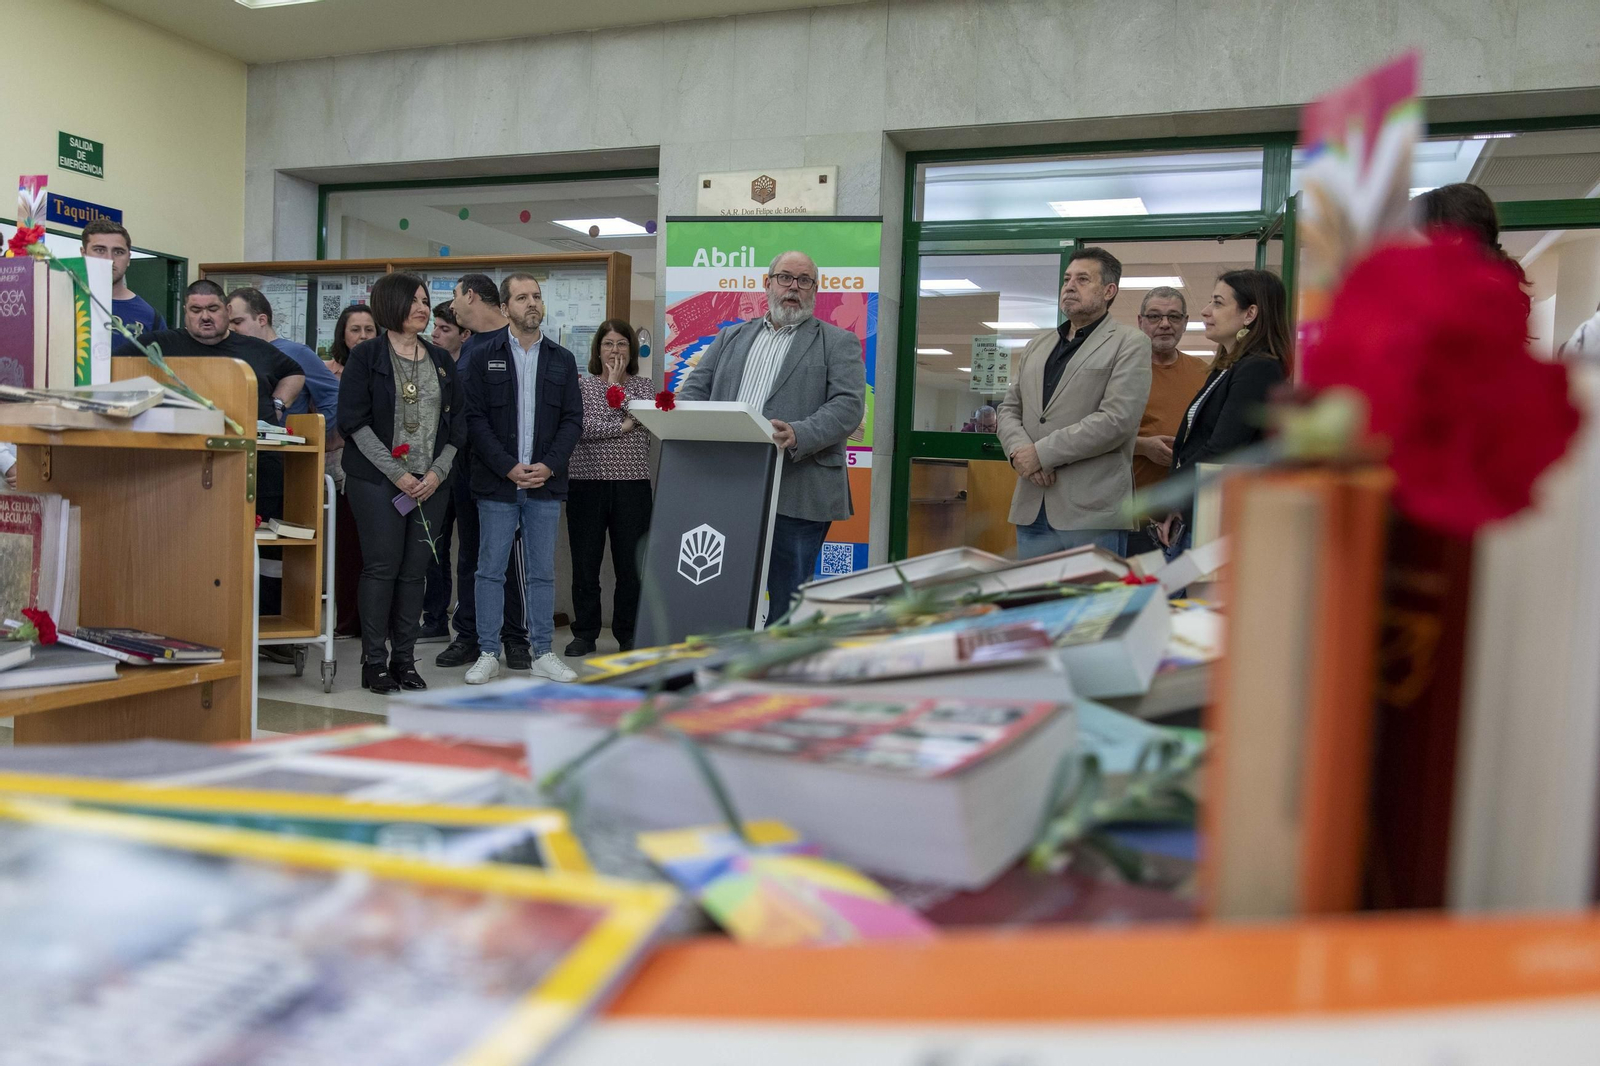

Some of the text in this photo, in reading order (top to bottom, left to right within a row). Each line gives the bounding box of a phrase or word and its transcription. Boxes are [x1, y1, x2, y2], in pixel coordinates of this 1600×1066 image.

[69, 137, 94, 152] SALIDA
[76, 150, 87, 160] DE
[59, 156, 103, 175] EMERGENCIA
[756, 207, 773, 216] Felipe
[784, 206, 807, 214] Borbón
[693, 246, 755, 267] Abril
[719, 277, 737, 288] en
[742, 275, 756, 288] la
[11, 502, 40, 513] CELULAR
[0, 512, 32, 524] LECULAR
